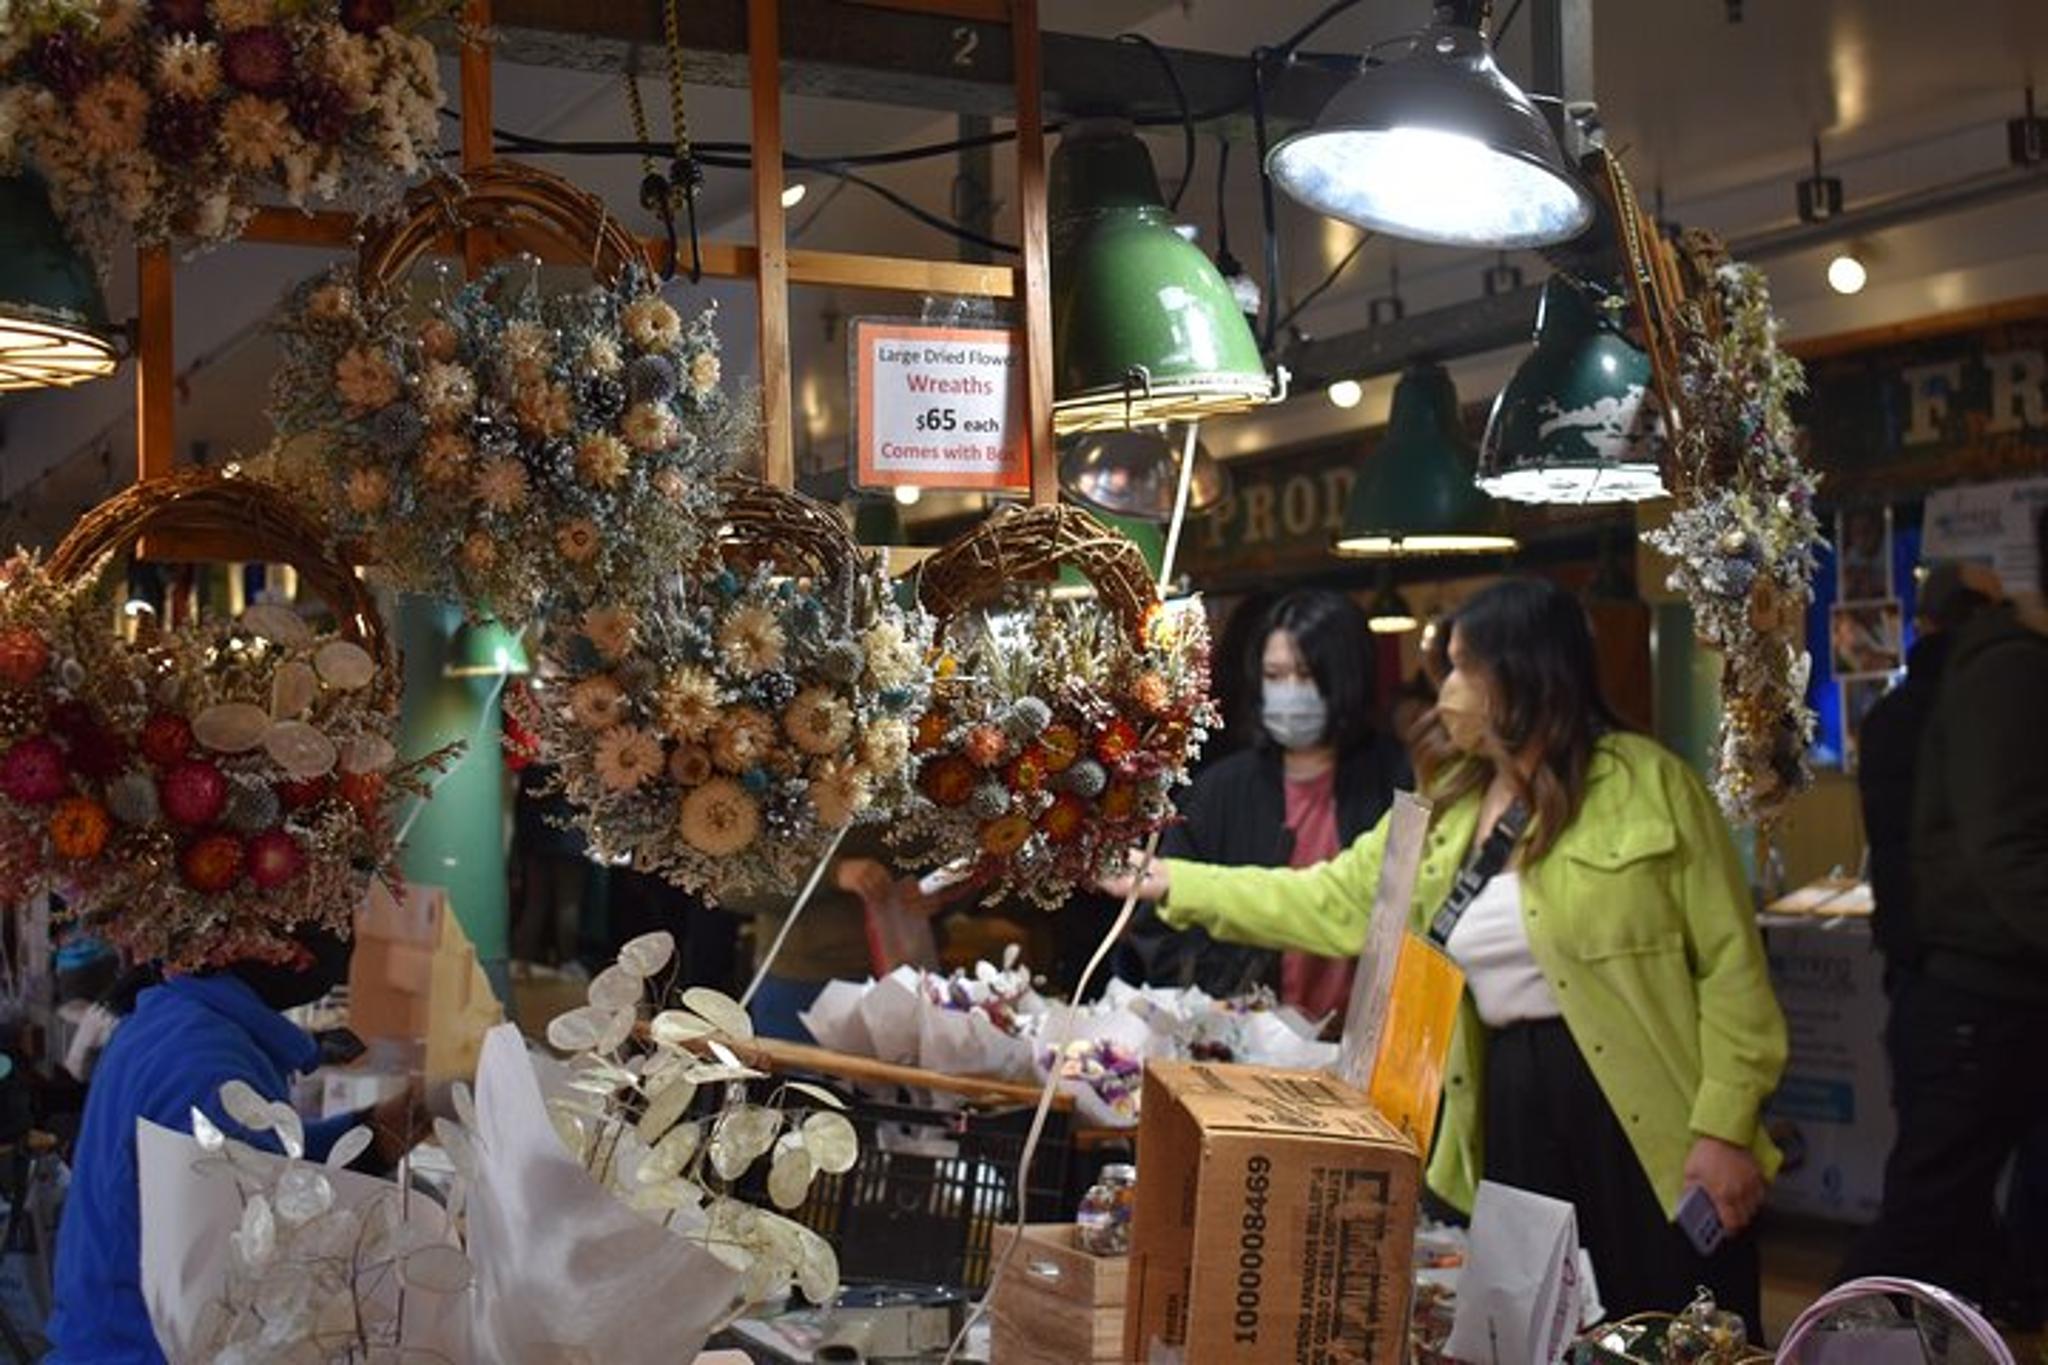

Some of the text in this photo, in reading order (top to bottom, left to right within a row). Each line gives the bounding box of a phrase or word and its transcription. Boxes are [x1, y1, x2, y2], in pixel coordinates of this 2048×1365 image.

[952, 26, 979, 65] 2
[879, 348, 921, 365] Large
[924, 348, 964, 364] Dried
[907, 374, 993, 395] Wreaths
[916, 408, 999, 433] $65 each
[881, 443, 940, 459] Comes
[944, 445, 982, 460] with
[1234, 1155, 1271, 1344] 1000008469
